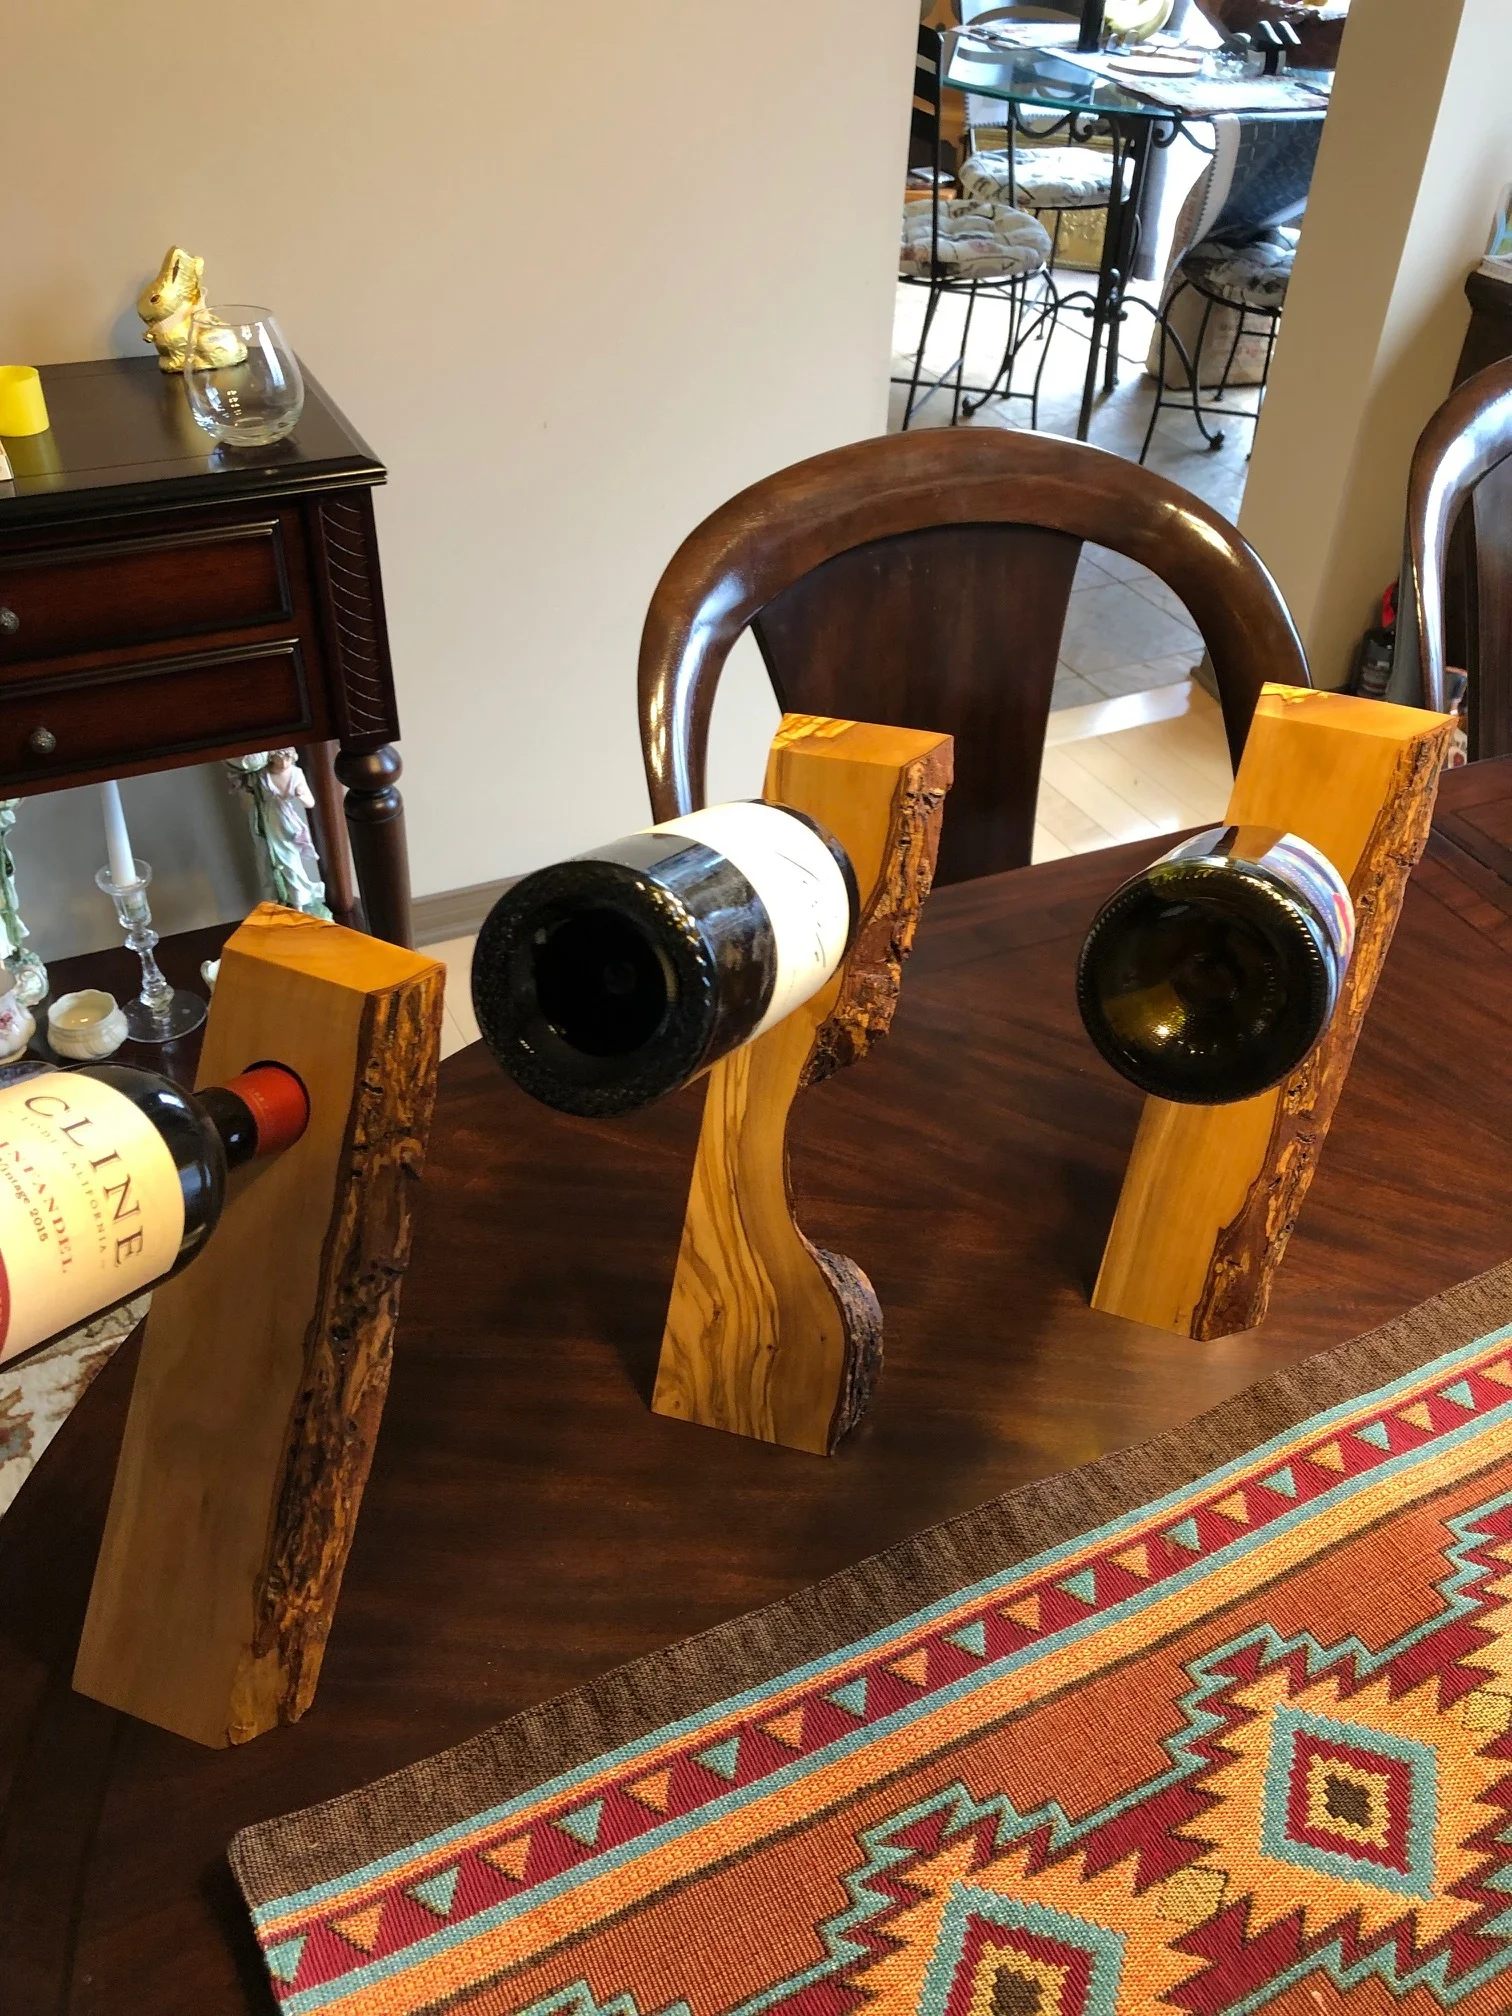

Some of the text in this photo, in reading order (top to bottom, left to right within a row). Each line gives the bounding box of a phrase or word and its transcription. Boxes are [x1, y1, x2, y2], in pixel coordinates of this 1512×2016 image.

[0, 1141, 73, 1273] INFANDEL
[25, 1096, 143, 1267] CLINE
[62, 1151, 106, 1253] CALIFORNIA
